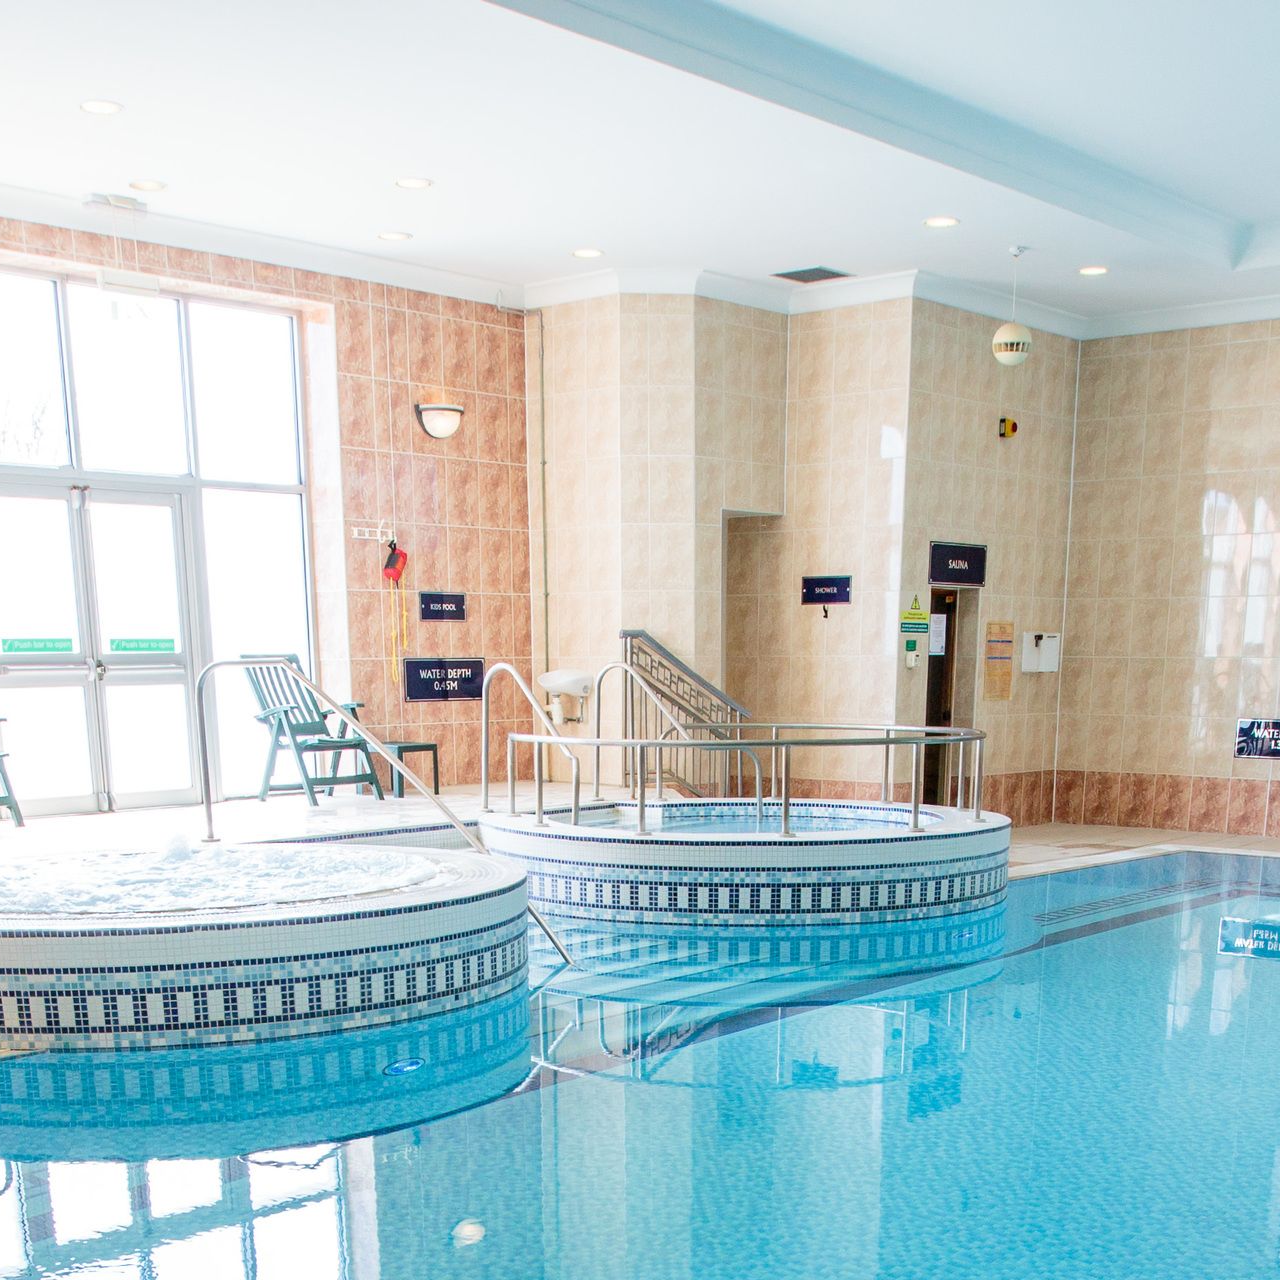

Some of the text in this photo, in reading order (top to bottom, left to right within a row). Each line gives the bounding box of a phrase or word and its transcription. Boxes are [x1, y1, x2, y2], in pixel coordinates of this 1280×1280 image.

[948, 559, 968, 570] SAUNA
[815, 586, 837, 594] SHOWER
[430, 603, 456, 611] KIDS POOL
[419, 668, 471, 679] WATER DEPTH
[434, 681, 458, 691] 0.45M
